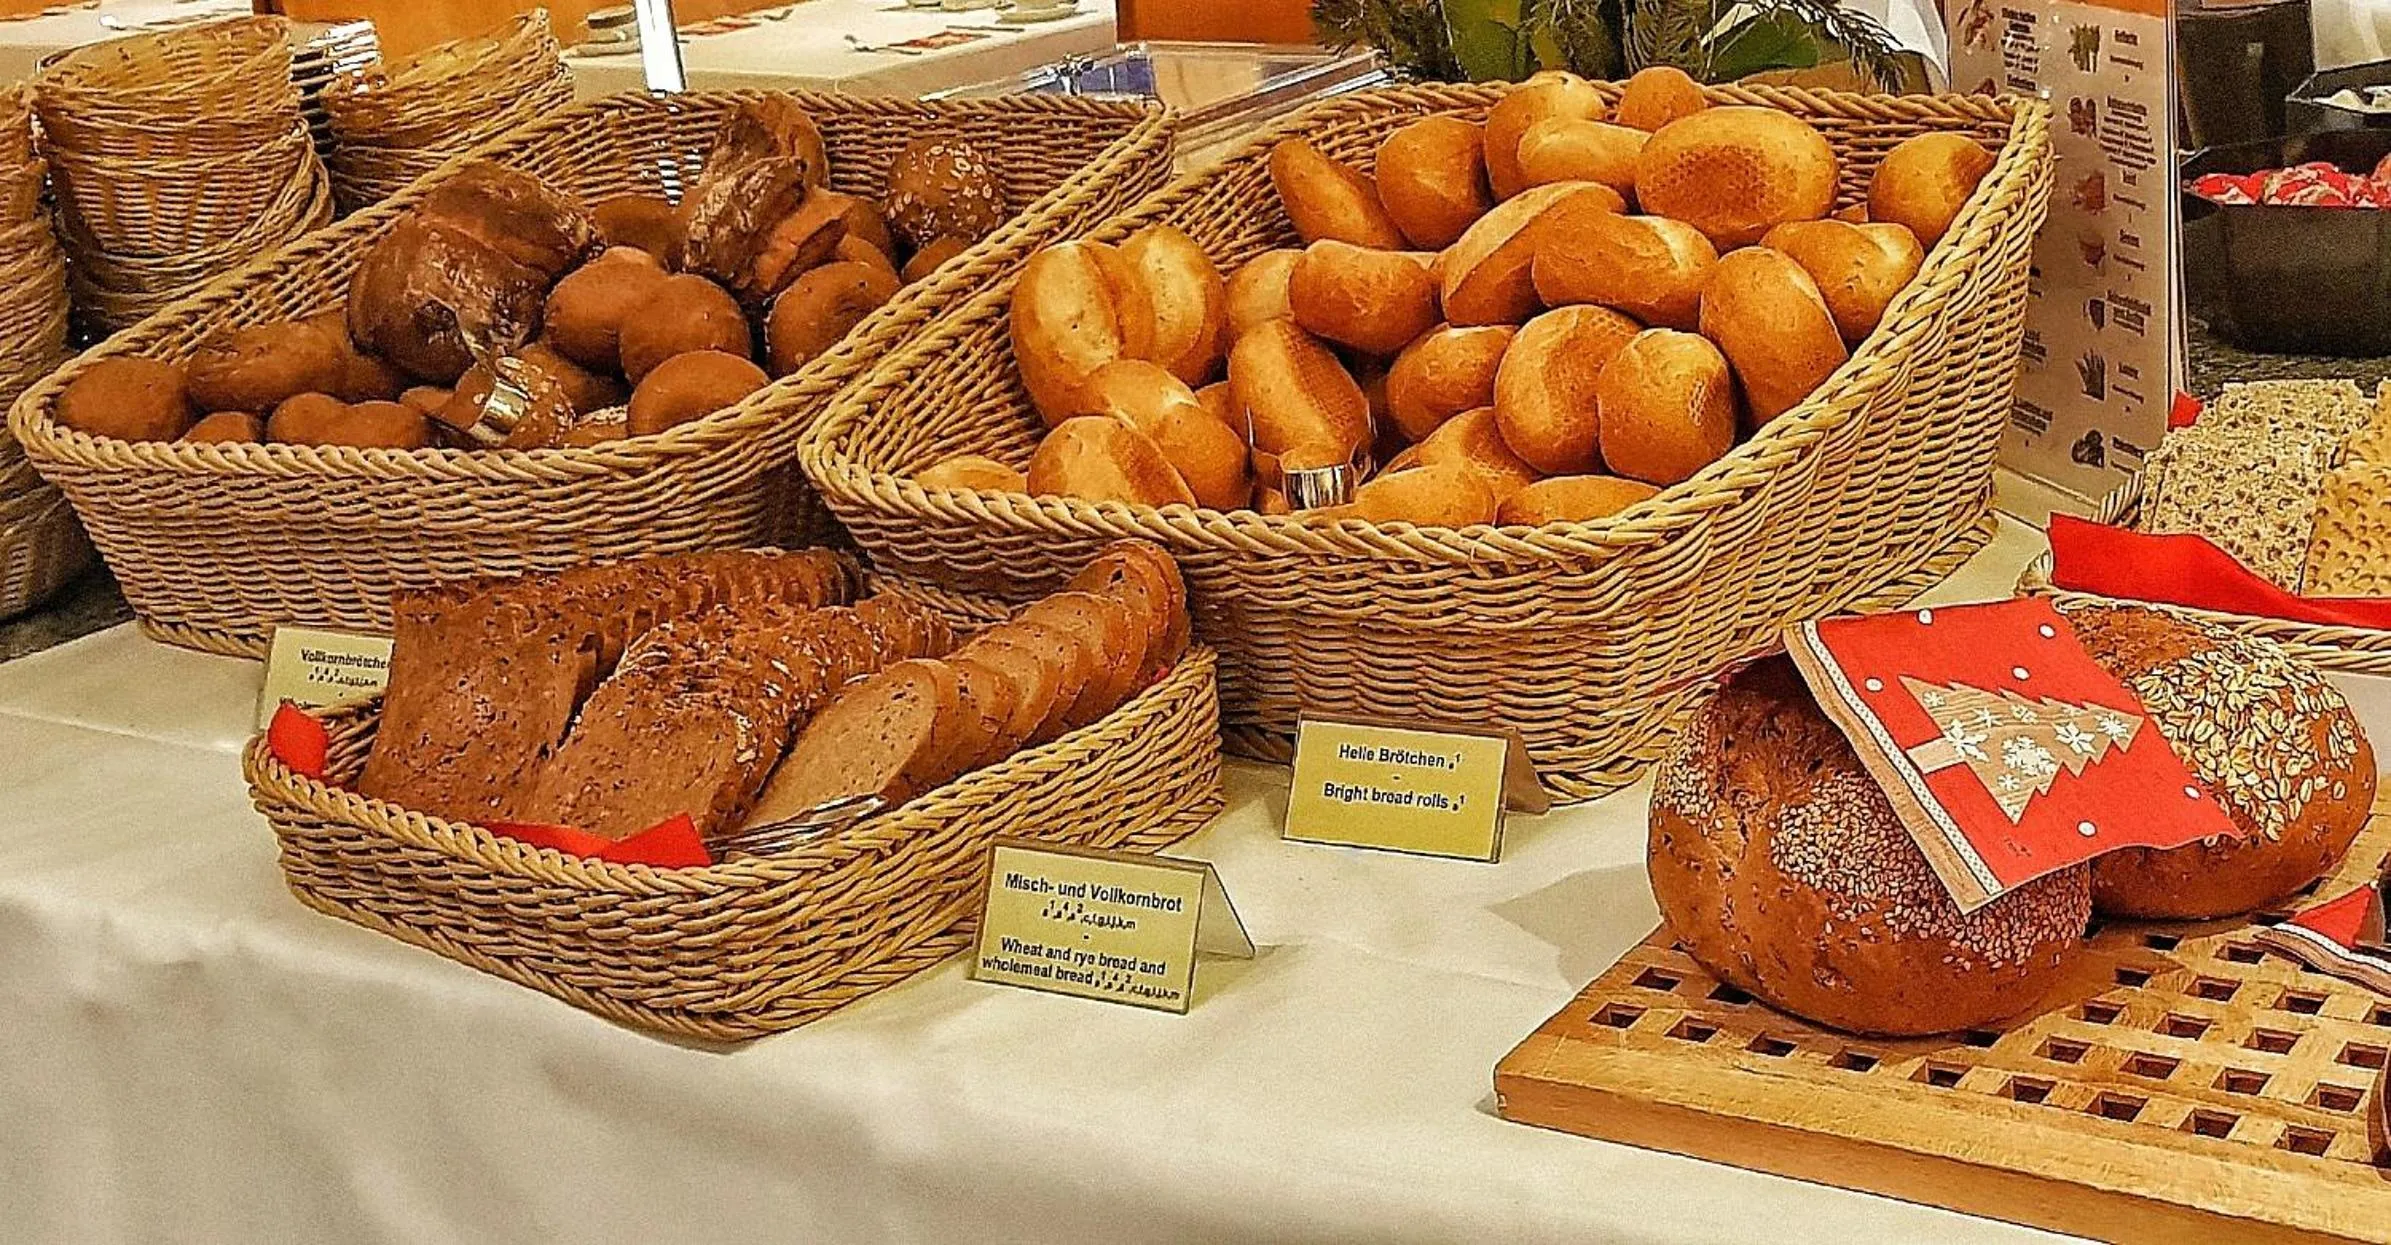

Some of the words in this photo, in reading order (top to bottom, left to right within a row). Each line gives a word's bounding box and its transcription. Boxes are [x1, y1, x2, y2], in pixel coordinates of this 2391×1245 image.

[1339, 744, 1375, 761] Helle
[1379, 747, 1445, 768] Brötchen
[1324, 782, 1368, 803] Bright
[1372, 789, 1413, 806] bread
[1417, 793, 1448, 809] rolls
[1005, 873, 1055, 893] Misch-
[1058, 883, 1086, 899] und
[1091, 885, 1182, 912] Vollkornbrot
[1001, 937, 1043, 957] Wheat
[1045, 947, 1071, 962] and
[1074, 953, 1095, 967] rye
[1100, 953, 1136, 972] bread
[1140, 961, 1166, 976] and
[982, 957, 1053, 979] wholemeal
[1056, 966, 1093, 985] bread
